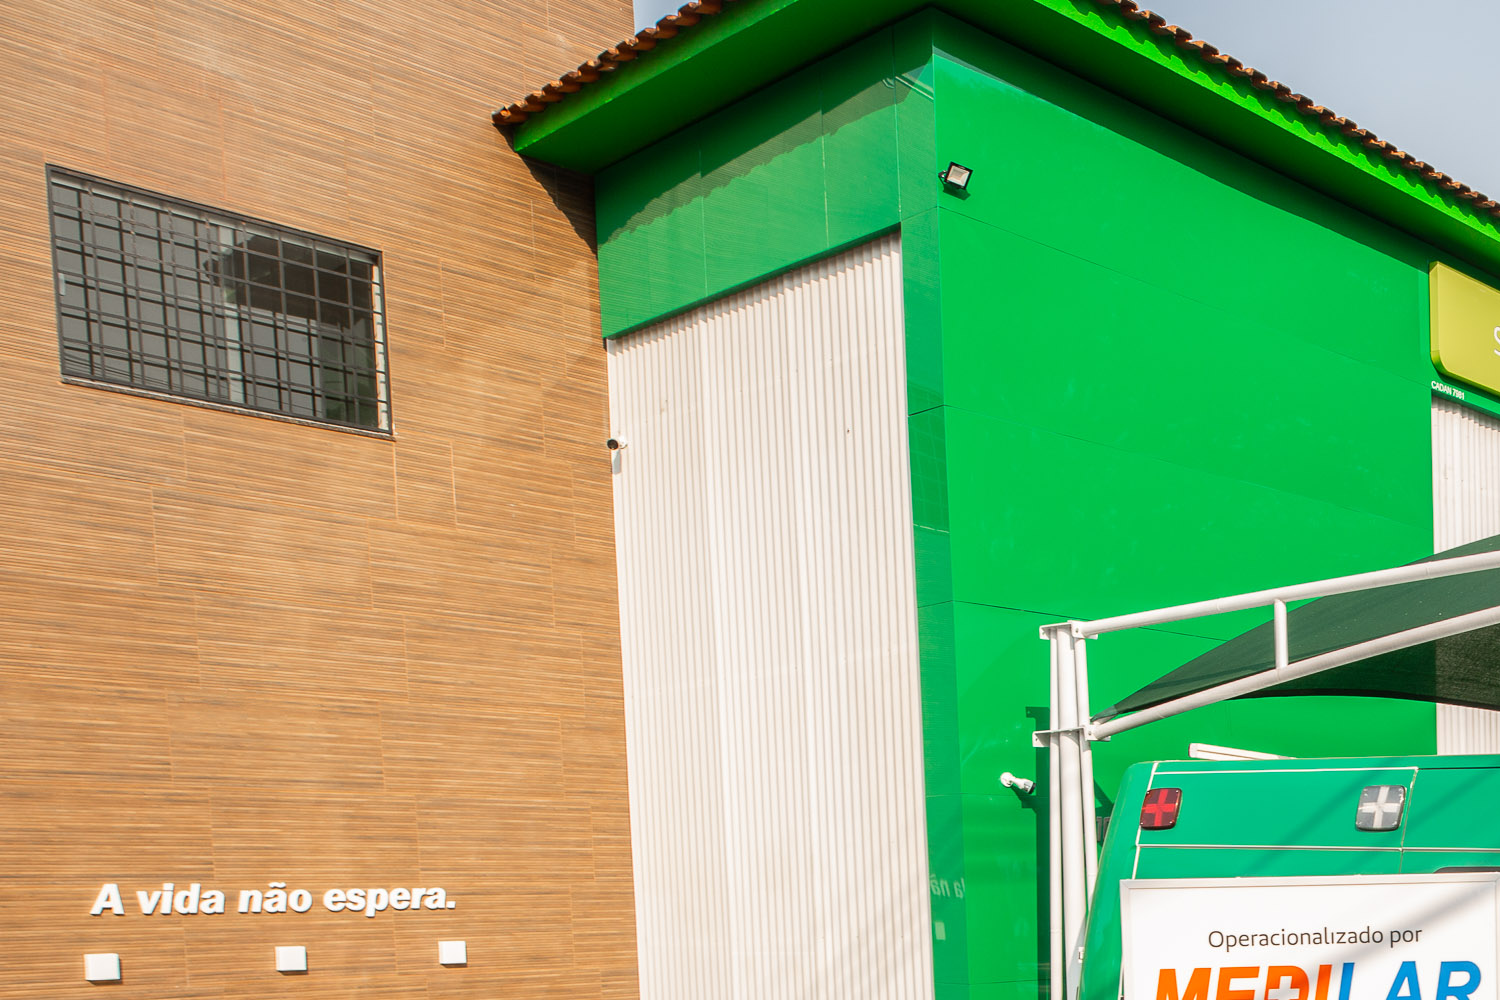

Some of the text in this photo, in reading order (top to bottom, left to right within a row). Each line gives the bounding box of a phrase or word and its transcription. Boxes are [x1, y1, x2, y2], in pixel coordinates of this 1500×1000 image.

[1431, 381, 1452, 395] CADAN
[90, 881, 456, 917] A vida não espera.
[1208, 926, 1422, 952] Operacionalizado por
